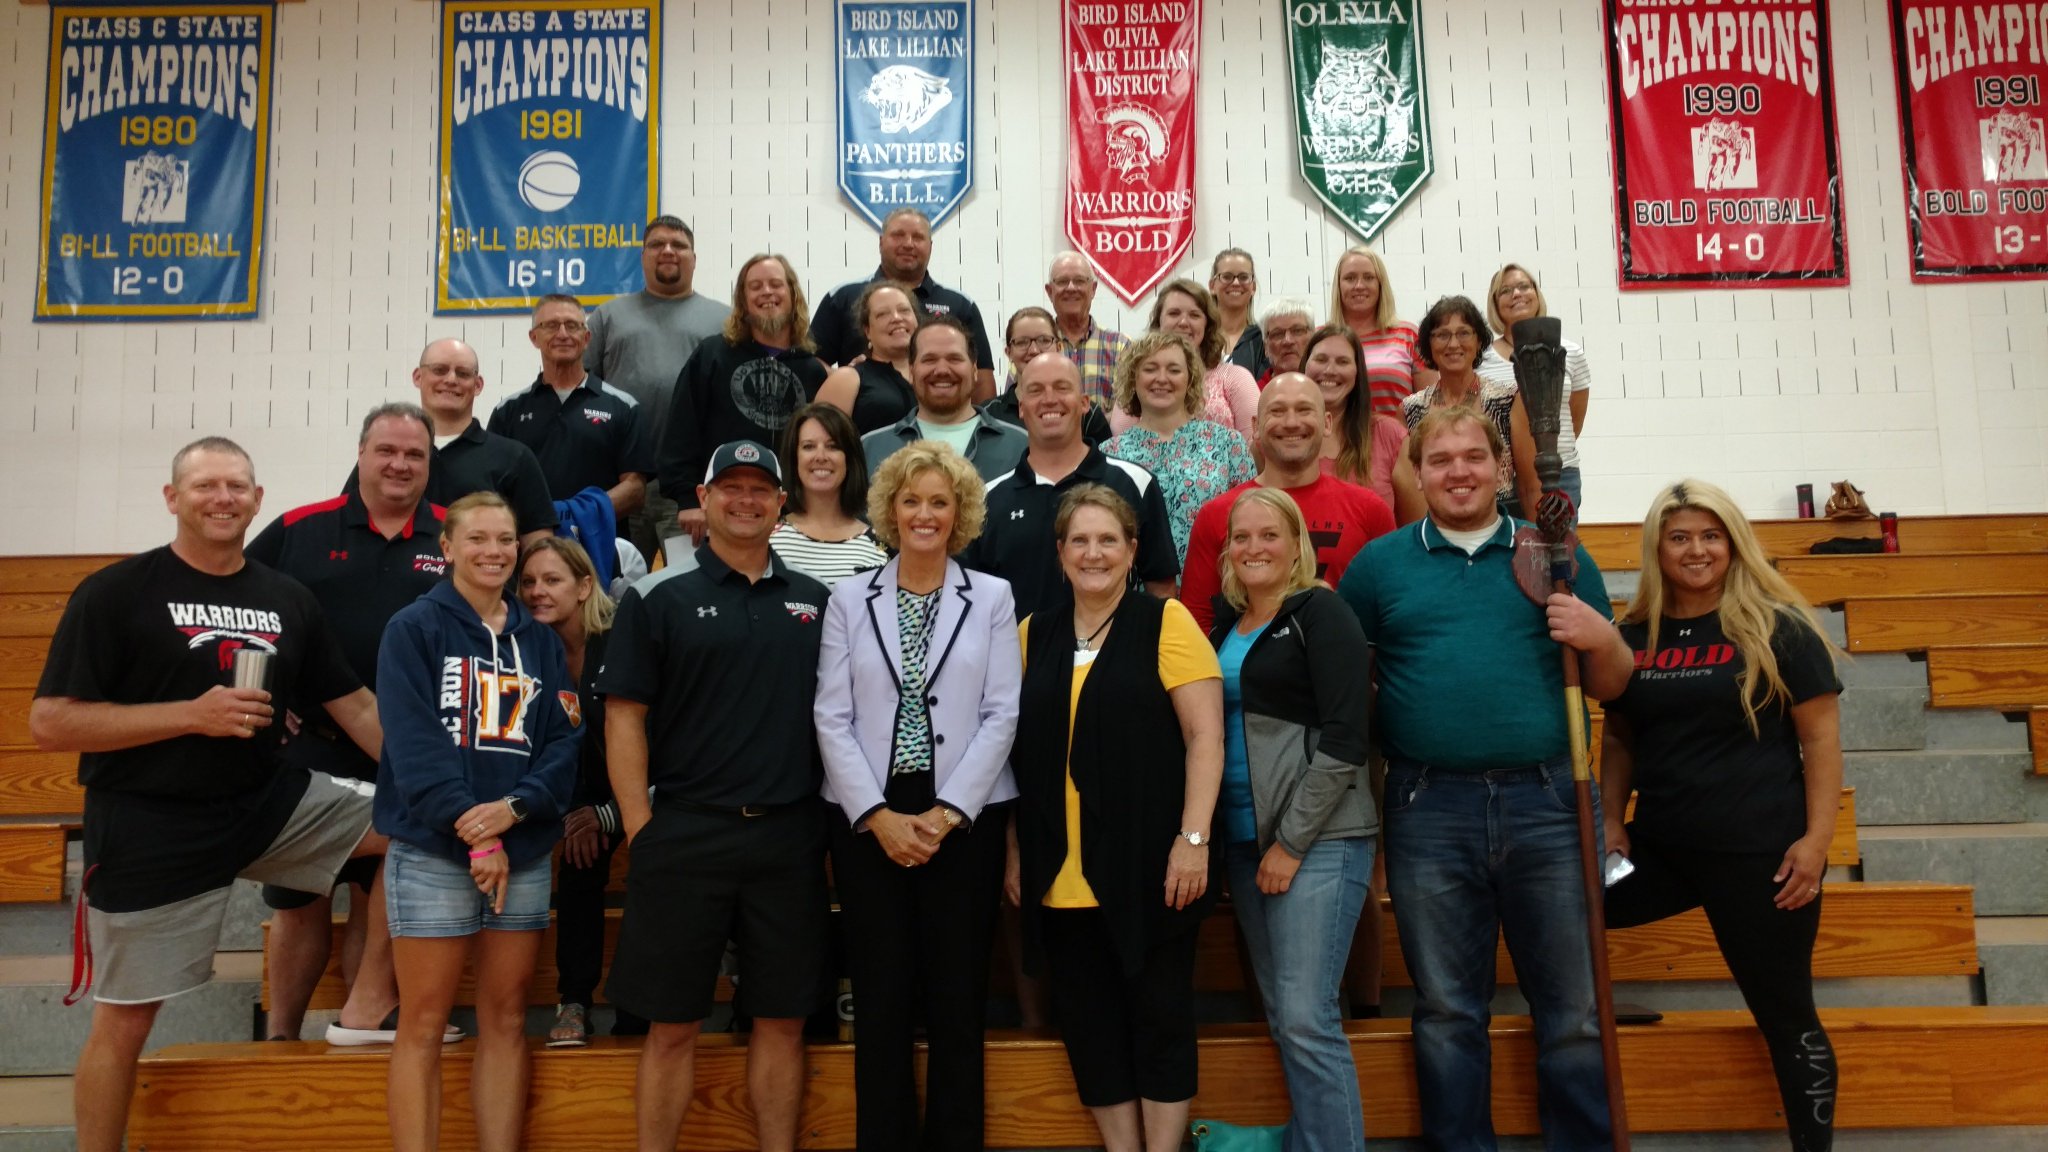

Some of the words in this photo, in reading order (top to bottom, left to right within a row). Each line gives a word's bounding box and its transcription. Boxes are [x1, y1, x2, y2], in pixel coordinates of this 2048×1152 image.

[459, 11, 535, 33] CLASS
[546, 11, 562, 31] A
[573, 9, 646, 30] STATE
[851, 10, 891, 31] BIRD
[897, 10, 959, 30] ISLAND
[1078, 4, 1118, 26] BIRD
[1124, 2, 1186, 24] ISLAND
[1294, 0, 1407, 27] OLIVIA
[67, 17, 141, 39] CLASS
[152, 17, 165, 38] C
[178, 16, 257, 38] STATE
[1103, 27, 1160, 48] OLIVIA
[845, 37, 890, 59] LAKE
[896, 37, 963, 58] LILLIAN
[1073, 51, 1118, 72] LAKE
[1123, 49, 1190, 71] LILLIAN
[1620, 11, 1819, 100] CHAMPIONS
[60, 44, 258, 133] CHAMPIONS
[453, 36, 648, 126] CHAMPIONS
[1095, 74, 1170, 96] DISTRICT
[1974, 74, 2040, 108] 1991
[1683, 83, 1761, 116] 1990
[120, 115, 196, 146] 1980
[521, 109, 582, 140] 1981
[846, 142, 965, 165] PANTHERS
[869, 182, 944, 205] B.I.L.L.
[1074, 189, 1192, 214] WARRIORS
[1924, 189, 1987, 216] BOLD
[1635, 199, 1697, 226] BOLD
[1707, 197, 1825, 224] FOOTBALL
[60, 233, 118, 258] BI-LL
[129, 233, 240, 258] FOOTBALL
[453, 225, 506, 252] BI-LL
[515, 223, 644, 249] BASKETBALL
[1095, 231, 1172, 253] BOLD
[1696, 232, 1765, 261] 14-0
[113, 266, 183, 295] 12-0
[508, 258, 585, 287] 16-10
[422, 562, 446, 576] Golf
[167, 602, 282, 634] WARRIORS
[440, 656, 463, 709] RUN
[1640, 668, 1713, 681] Warriors
[478, 671, 535, 742] 17
[1795, 1029, 1834, 1138] alvin
